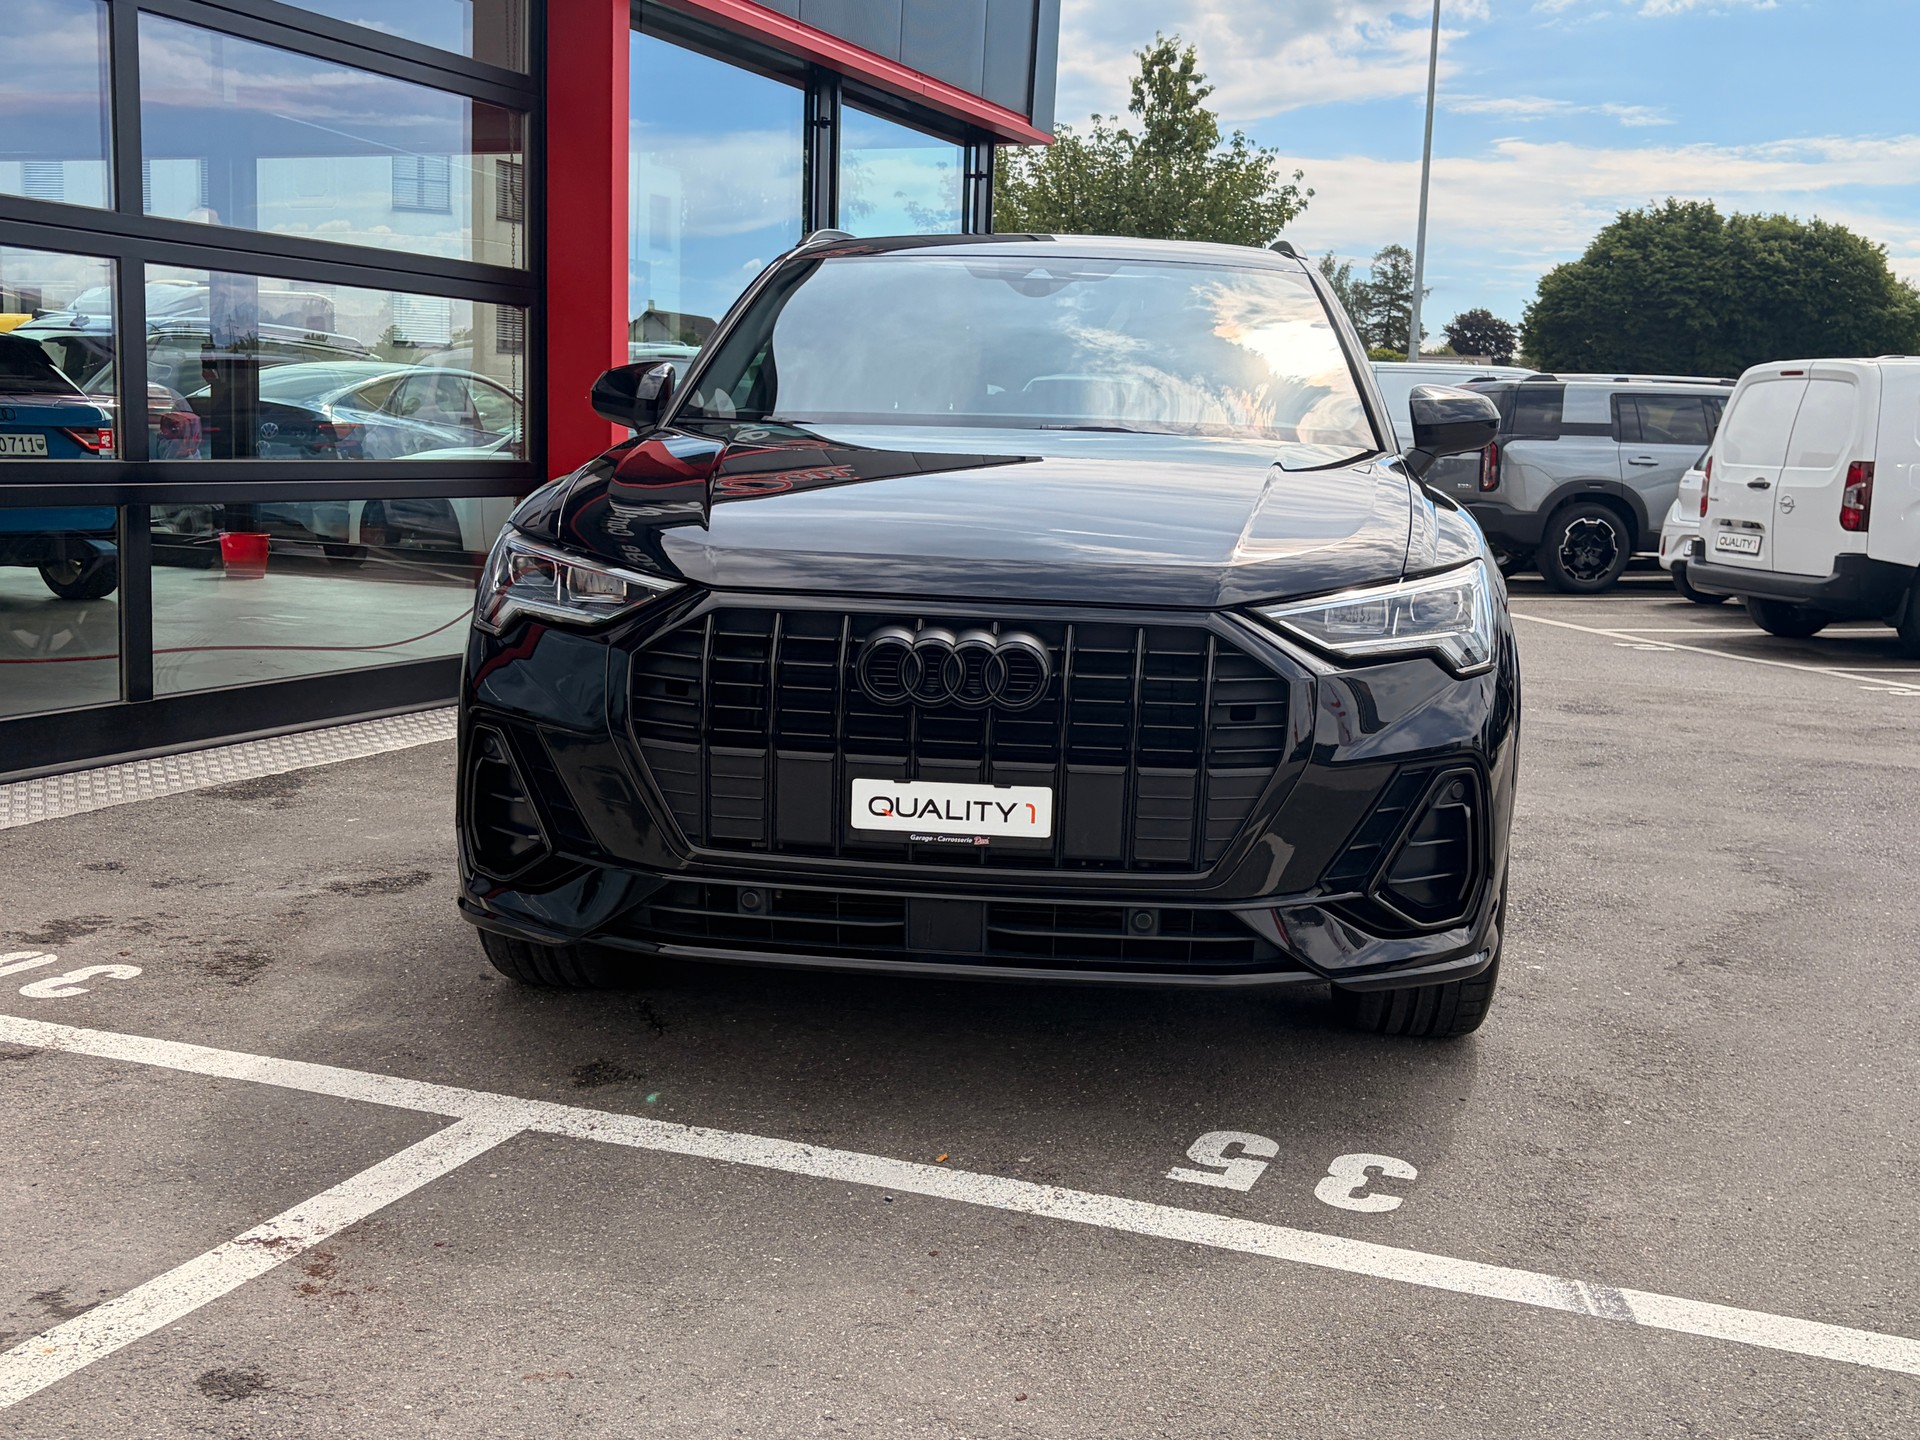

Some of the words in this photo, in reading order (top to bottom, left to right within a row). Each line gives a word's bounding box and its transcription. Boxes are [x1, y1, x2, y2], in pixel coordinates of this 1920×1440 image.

[1719, 536, 1753, 549] QUALITY
[867, 795, 1018, 823] QUALITY
[1025, 802, 1037, 824] 1
[910, 834, 933, 842] Garage
[937, 835, 973, 844] Carrosserie
[1165, 1130, 1418, 1213] 35
